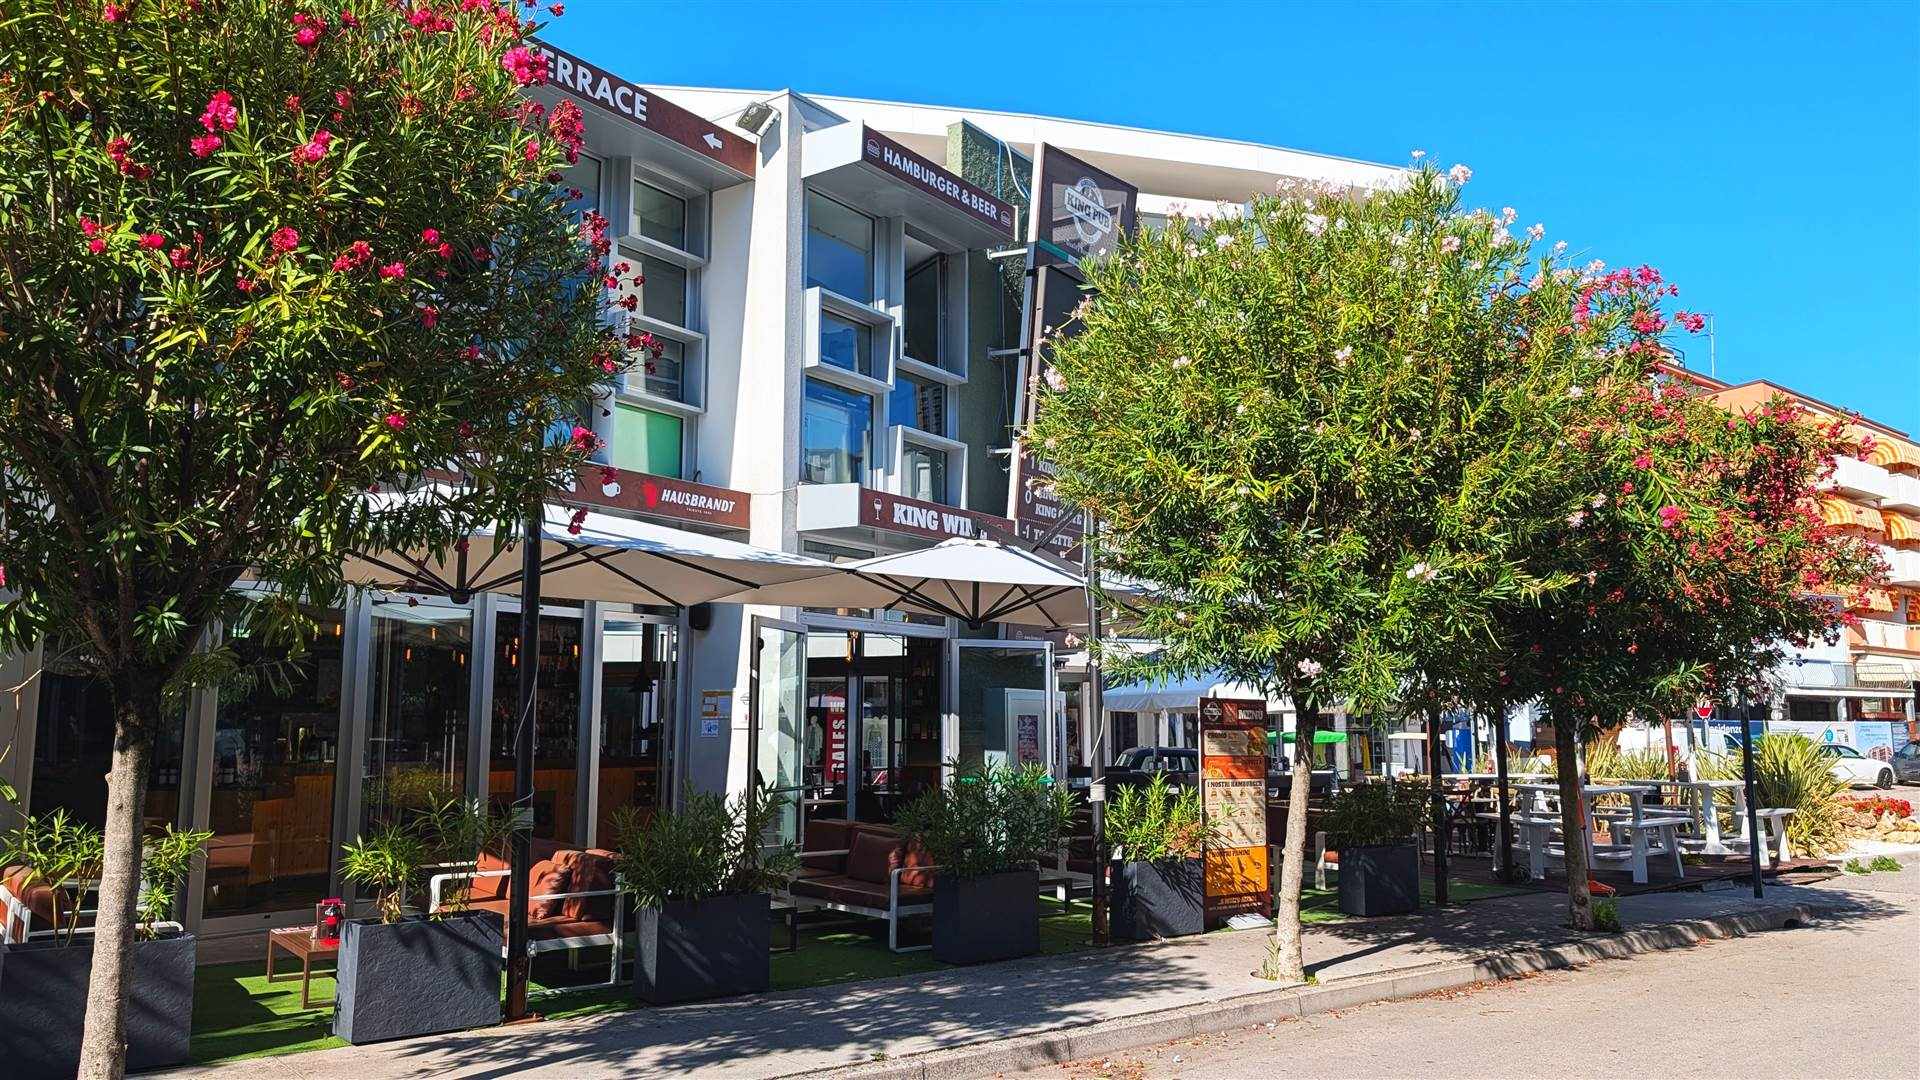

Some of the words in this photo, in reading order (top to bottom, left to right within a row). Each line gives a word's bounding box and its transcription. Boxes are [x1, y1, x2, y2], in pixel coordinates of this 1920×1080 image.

[522, 40, 648, 121] ERRACE
[884, 146, 959, 201] HAMBURGER
[961, 189, 971, 206] &
[971, 194, 998, 221] BEER
[1067, 192, 1092, 217] KING
[1092, 210, 1110, 228] PUB
[661, 488, 736, 513] HAUSBRANDT
[893, 502, 939, 531] KING
[1035, 503, 1057, 519] KING
